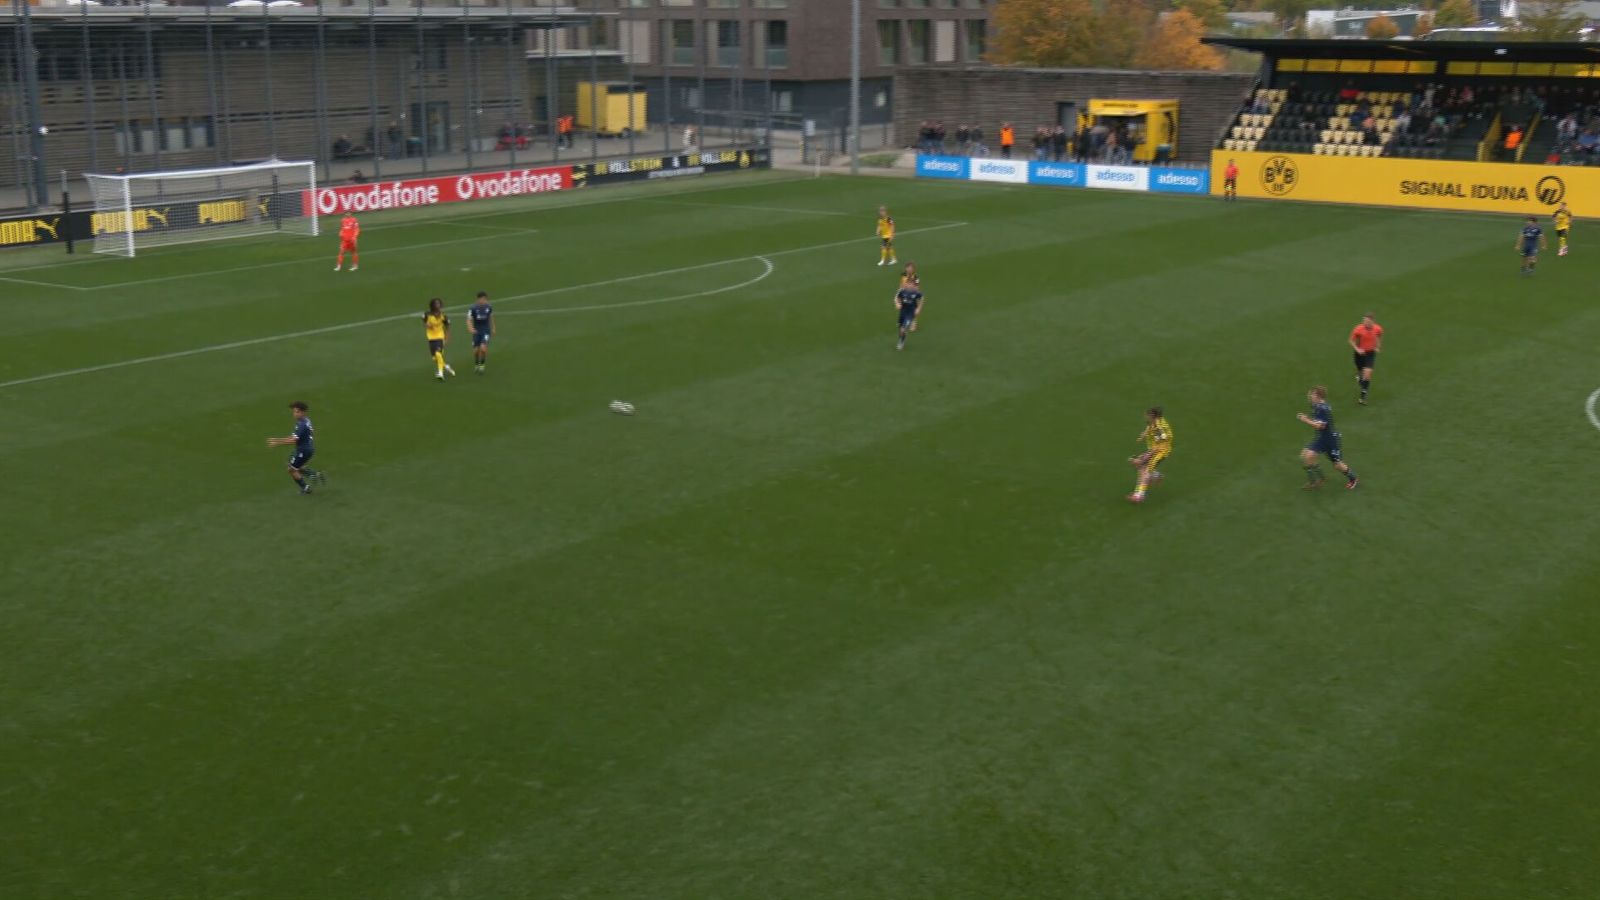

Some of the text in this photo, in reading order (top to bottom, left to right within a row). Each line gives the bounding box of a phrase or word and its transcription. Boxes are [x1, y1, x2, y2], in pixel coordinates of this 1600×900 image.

[923, 159, 959, 171] adesso
[979, 162, 1016, 175] adesso
[1036, 165, 1075, 179] adesso
[1265, 159, 1295, 184] BVB
[1096, 169, 1136, 182] adesso
[1158, 173, 1199, 187] adesso
[475, 169, 562, 197] vodafone
[338, 182, 439, 212] vodafone
[1400, 180, 1529, 202] SIGNAL IDUNA
